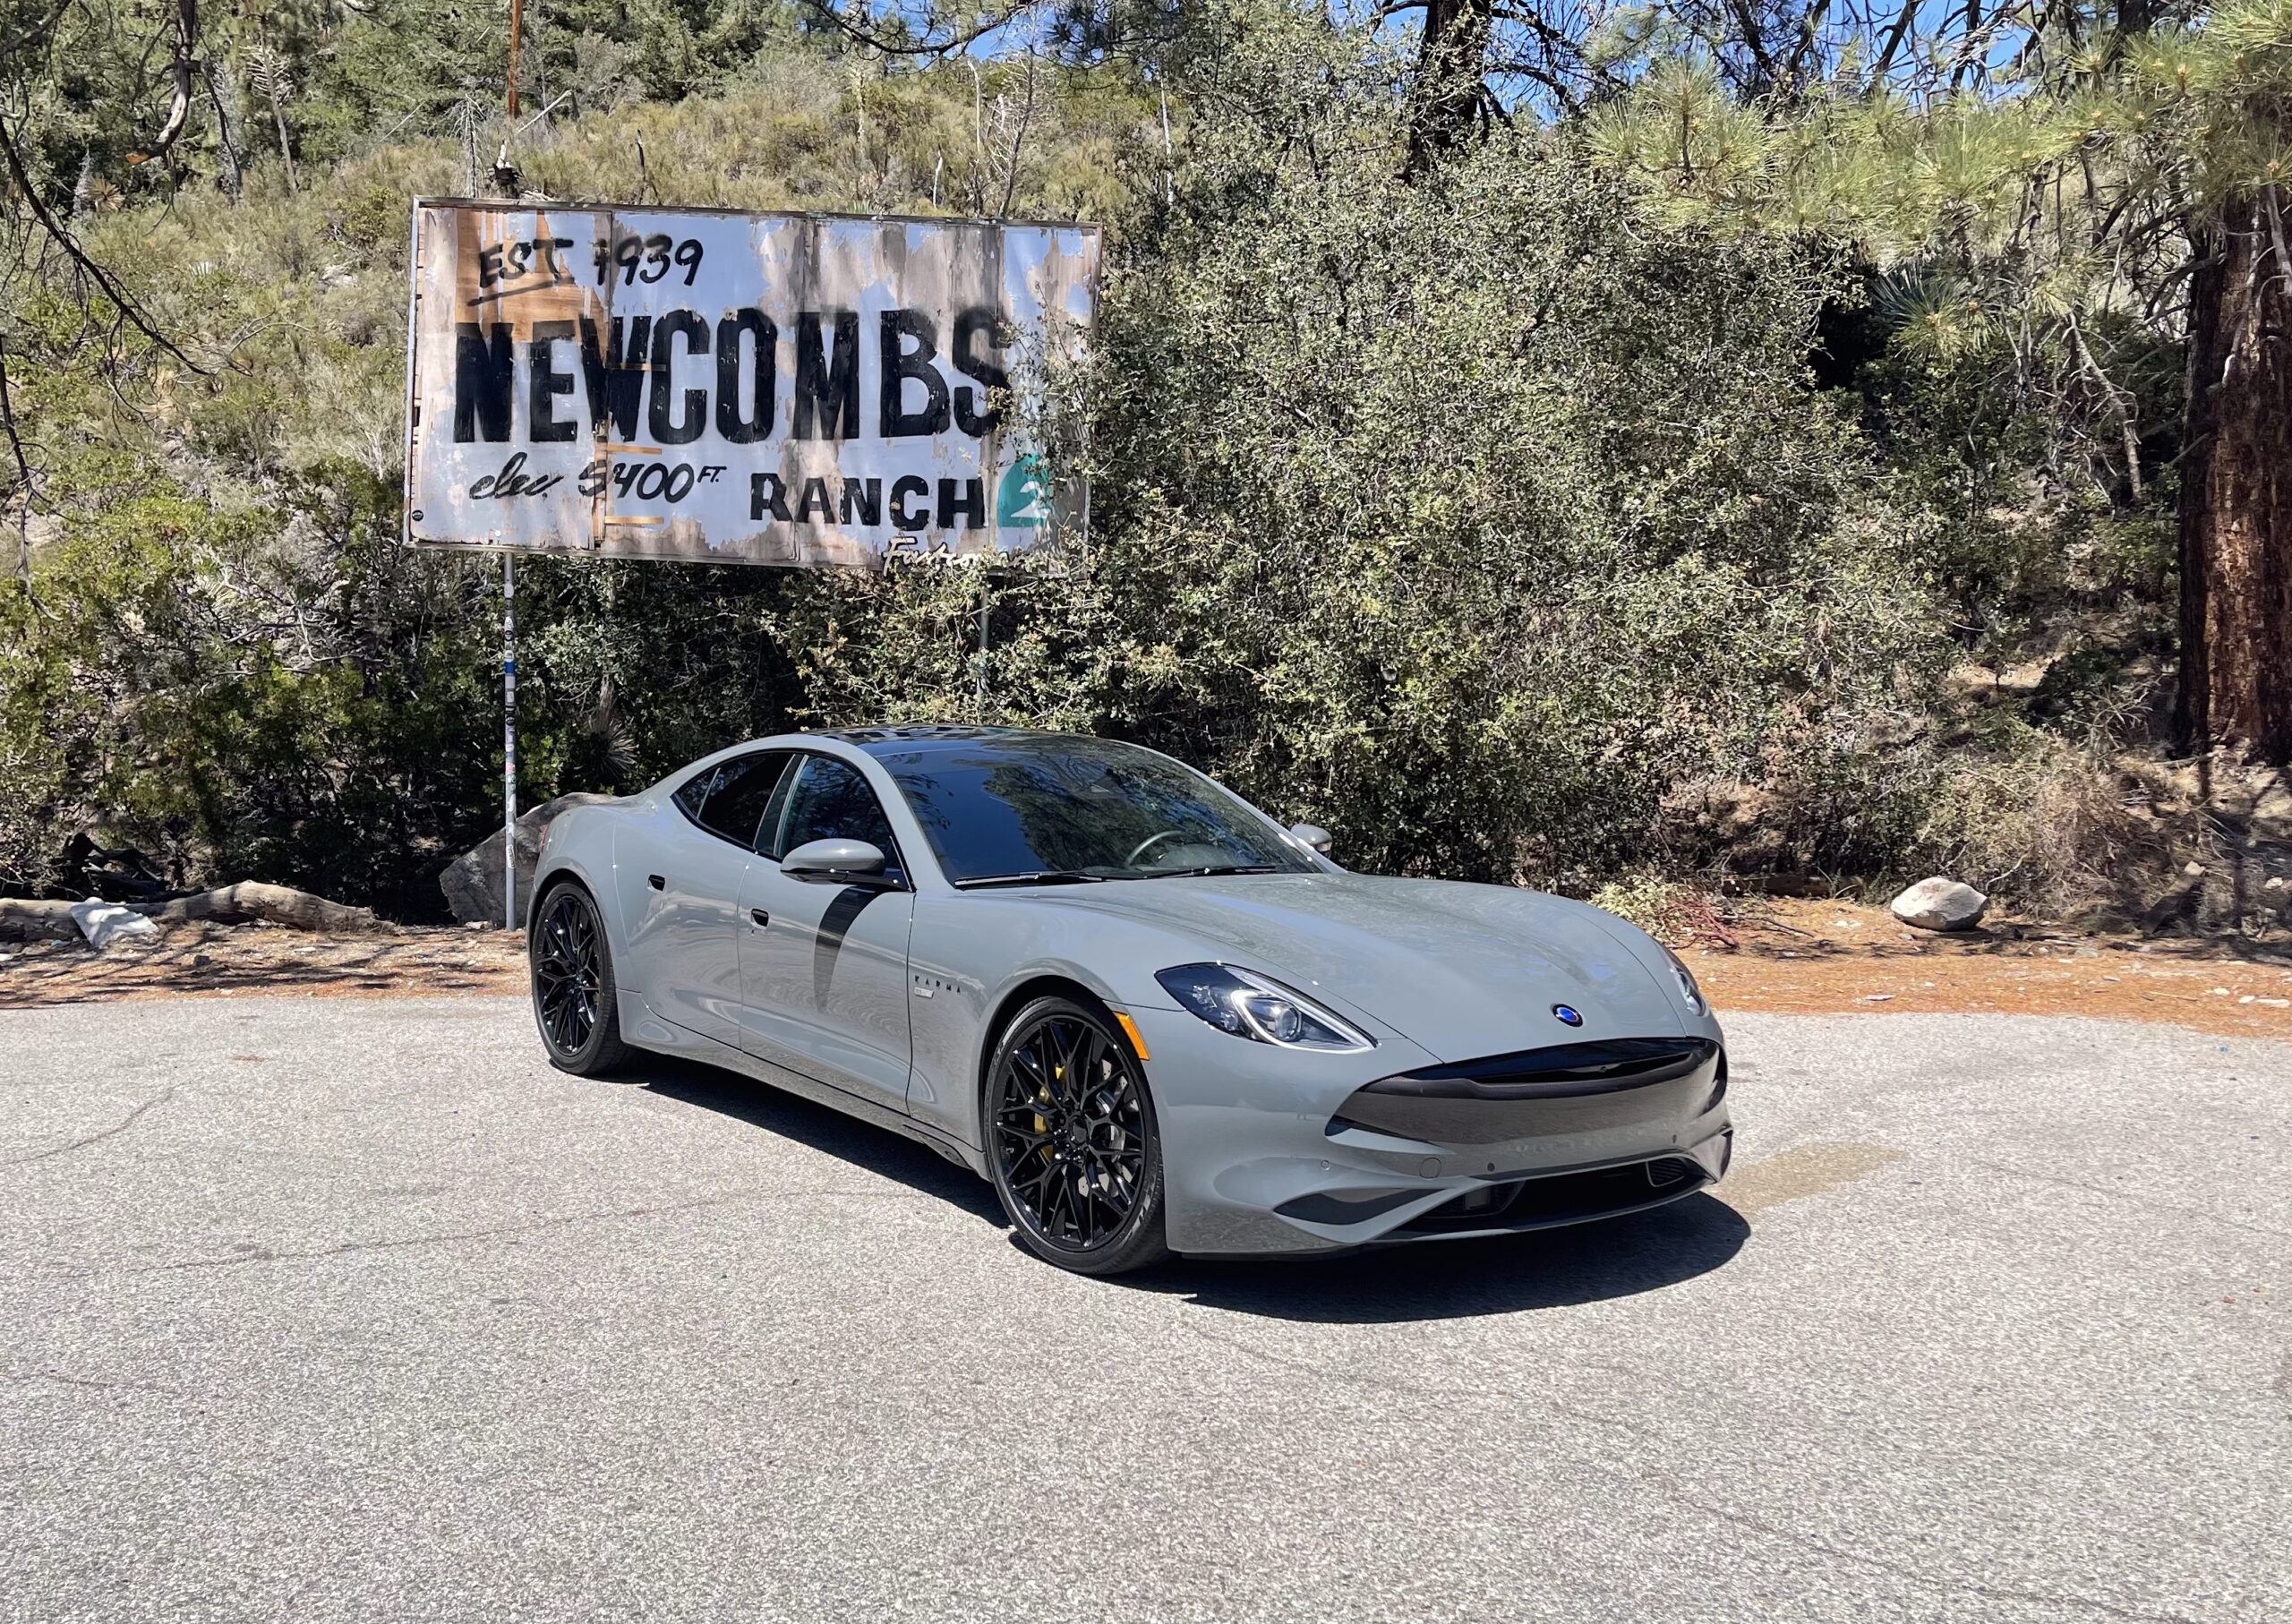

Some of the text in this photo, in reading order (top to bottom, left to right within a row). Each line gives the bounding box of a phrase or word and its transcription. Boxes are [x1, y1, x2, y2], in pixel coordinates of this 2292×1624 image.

[478, 234, 704, 288] EST 1939
[454, 306, 1011, 444] NEWCOMBS
[749, 472, 986, 531] RANCH
[1010, 480, 1051, 518] 2
